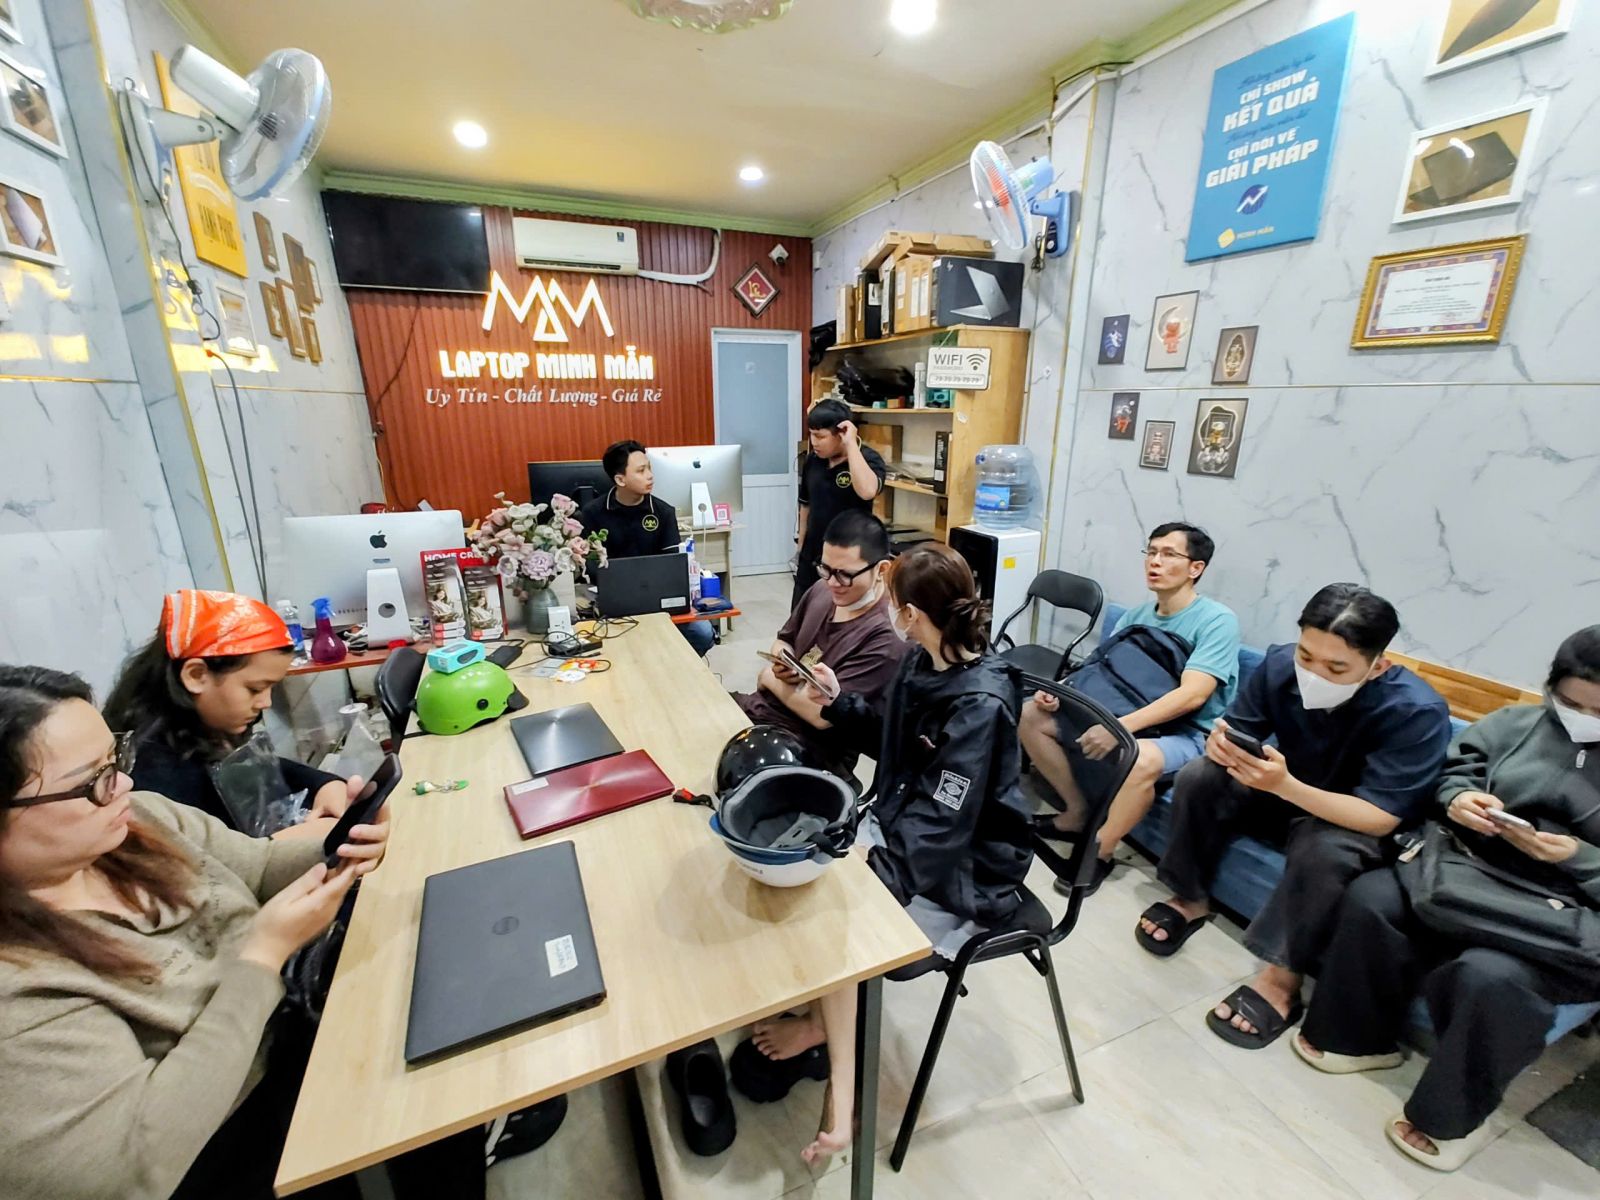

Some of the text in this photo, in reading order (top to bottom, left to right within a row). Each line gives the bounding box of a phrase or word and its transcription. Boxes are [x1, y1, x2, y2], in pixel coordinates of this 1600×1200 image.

[1263, 69, 1307, 95] SHOW
[1252, 139, 1319, 175] PHÁP
[439, 350, 530, 379] LAPTOP
[536, 353, 597, 379] MINH
[934, 354, 963, 365] WIFI
[426, 388, 451, 407] Uy
[457, 387, 488, 403] Tín
[504, 385, 542, 403] Chất
[549, 388, 598, 408] Lượng
[611, 387, 639, 403] Giá
